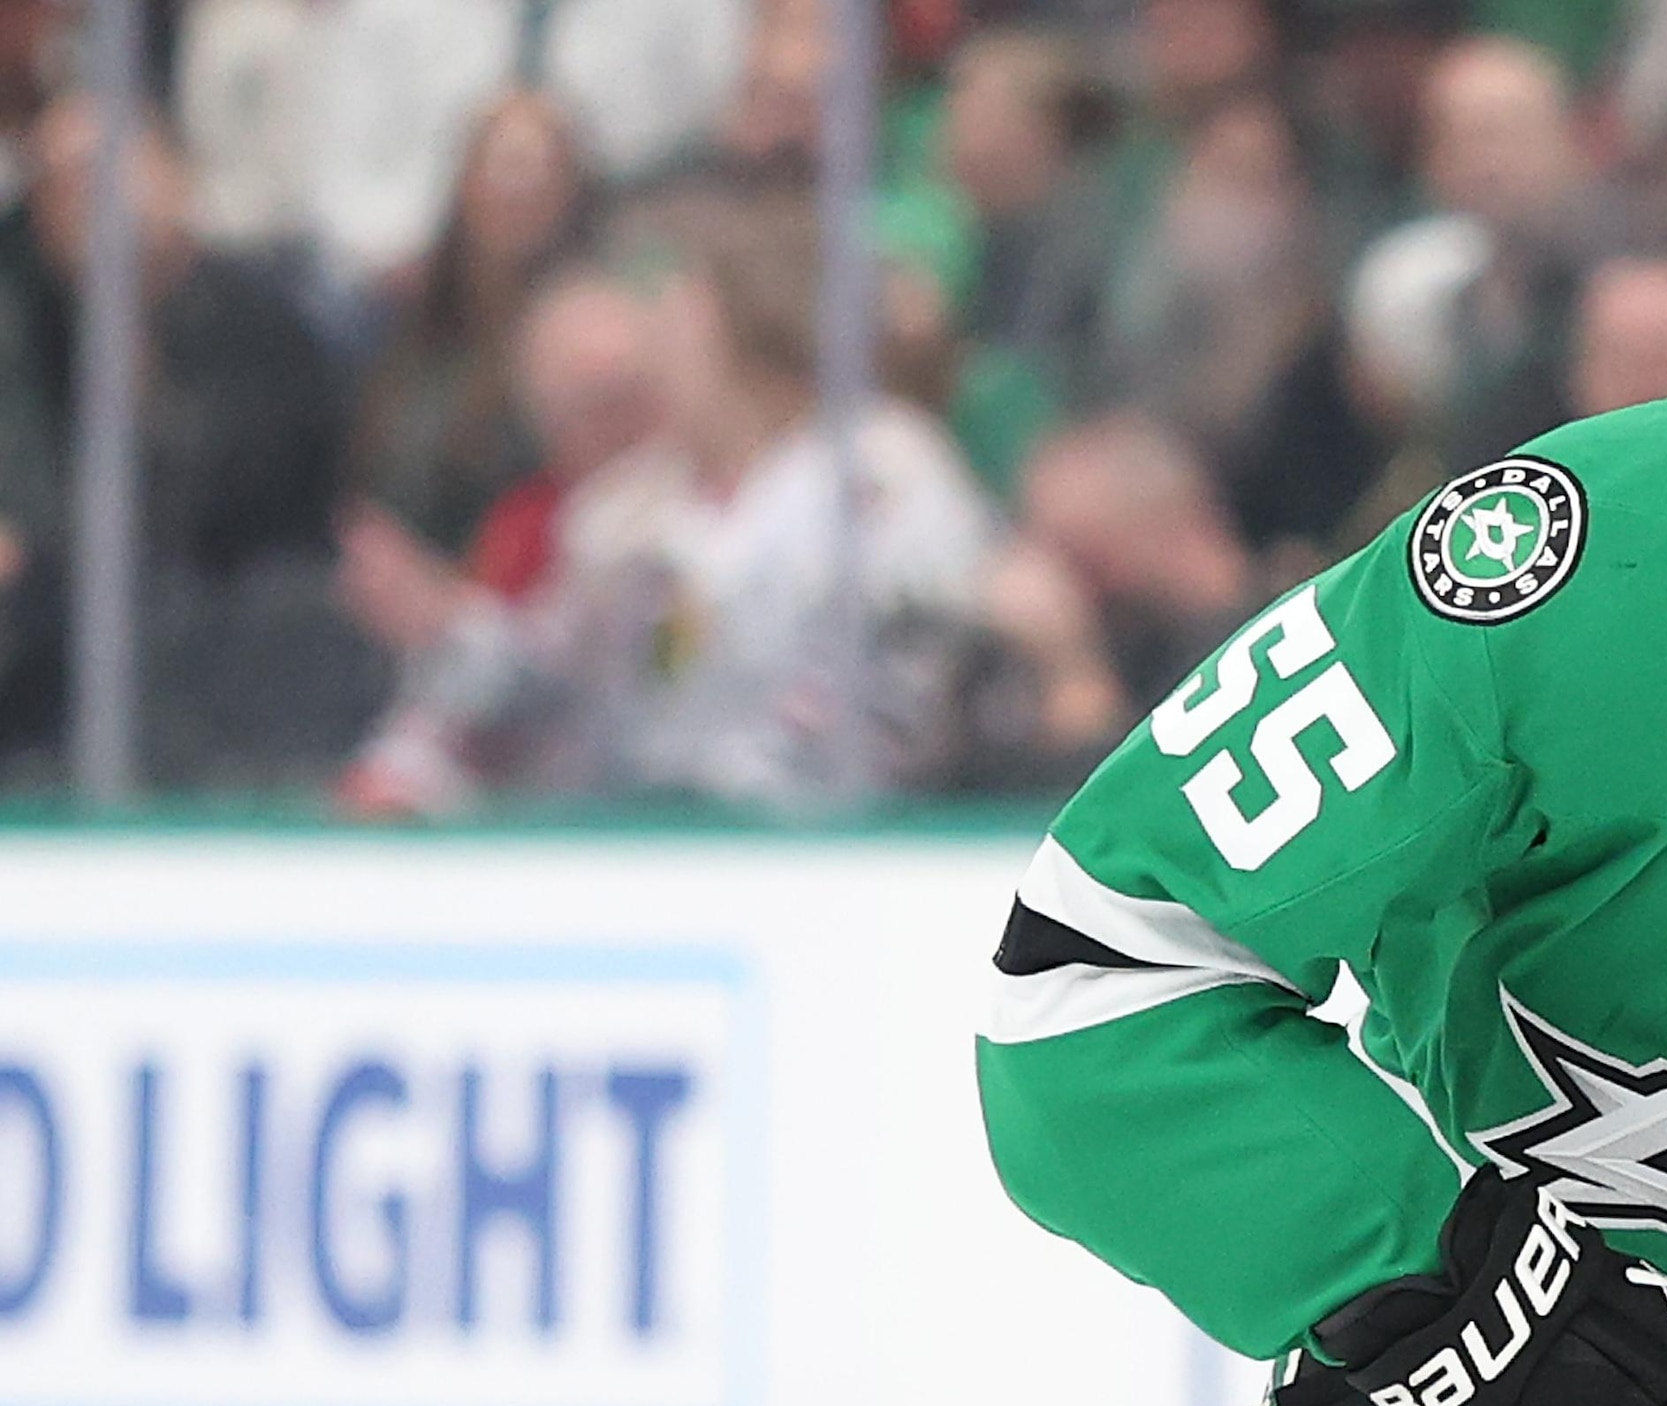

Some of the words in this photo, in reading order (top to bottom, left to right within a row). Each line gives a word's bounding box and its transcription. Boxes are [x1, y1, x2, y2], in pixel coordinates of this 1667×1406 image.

[1423, 490, 1475, 607] STARS
[1501, 469, 1569, 595] DALLAS
[1149, 583, 1398, 872] 55
[122, 1052, 698, 1340] LIGHT
